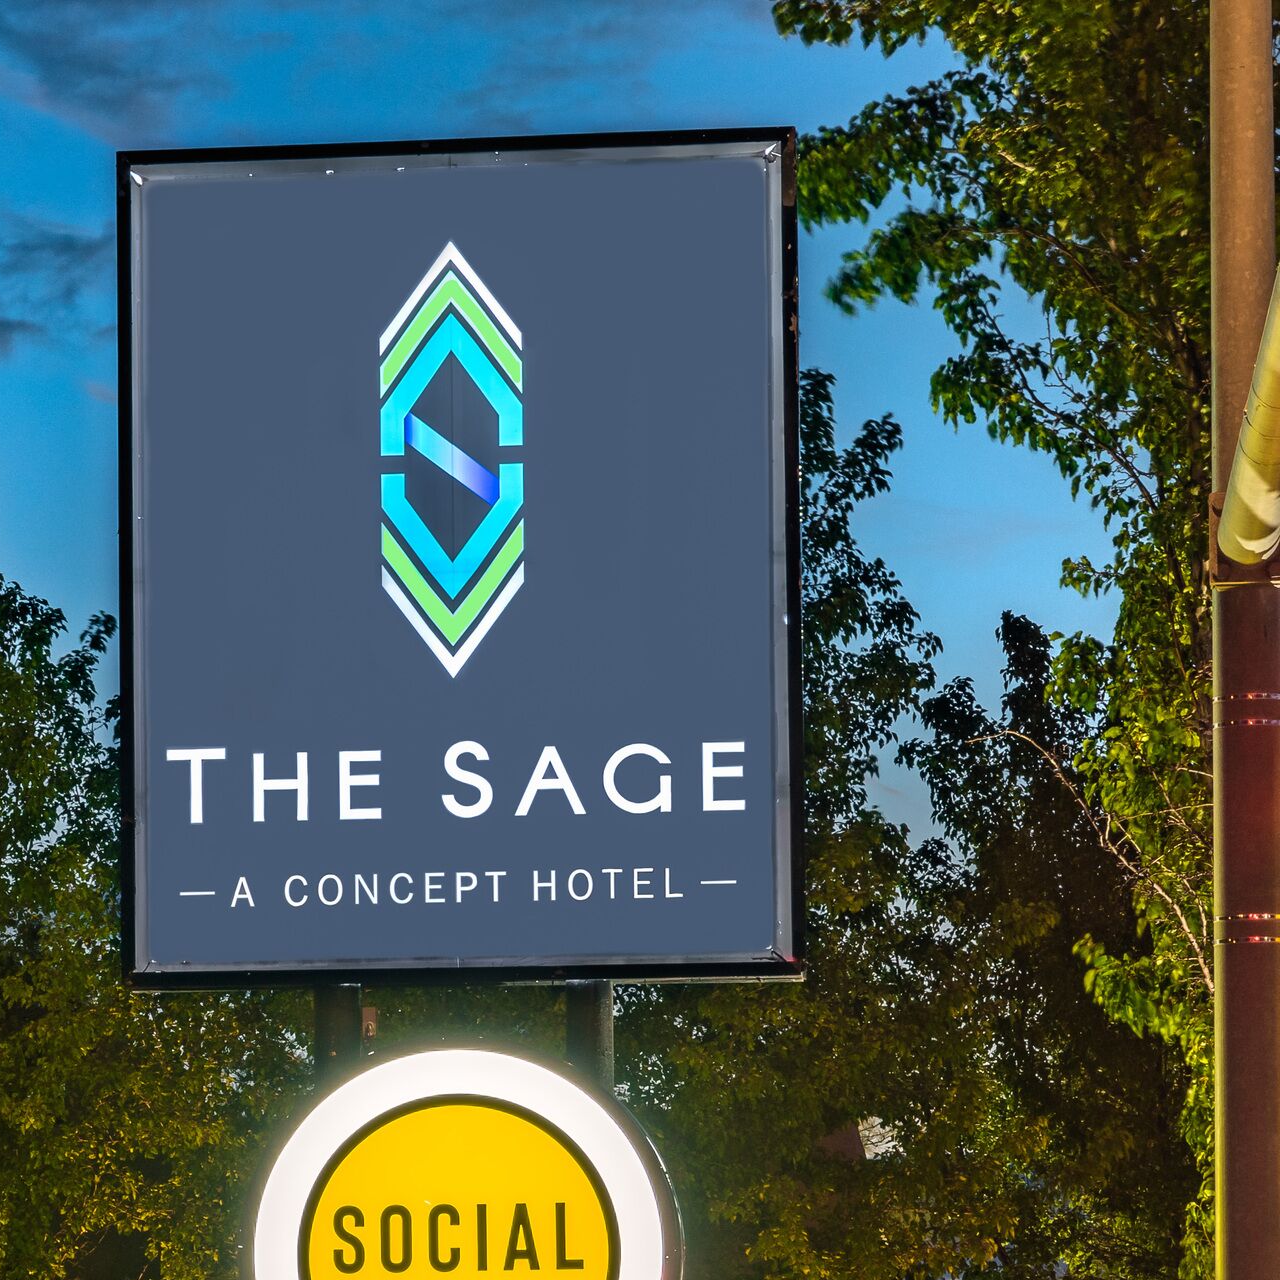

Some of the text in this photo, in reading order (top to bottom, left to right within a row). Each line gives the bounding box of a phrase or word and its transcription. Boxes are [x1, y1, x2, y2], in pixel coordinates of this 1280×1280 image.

[166, 740, 746, 824] THE SAGE
[230, 867, 684, 908] A CONCEPT HOTEL
[333, 1202, 585, 1275] SOCIAL
